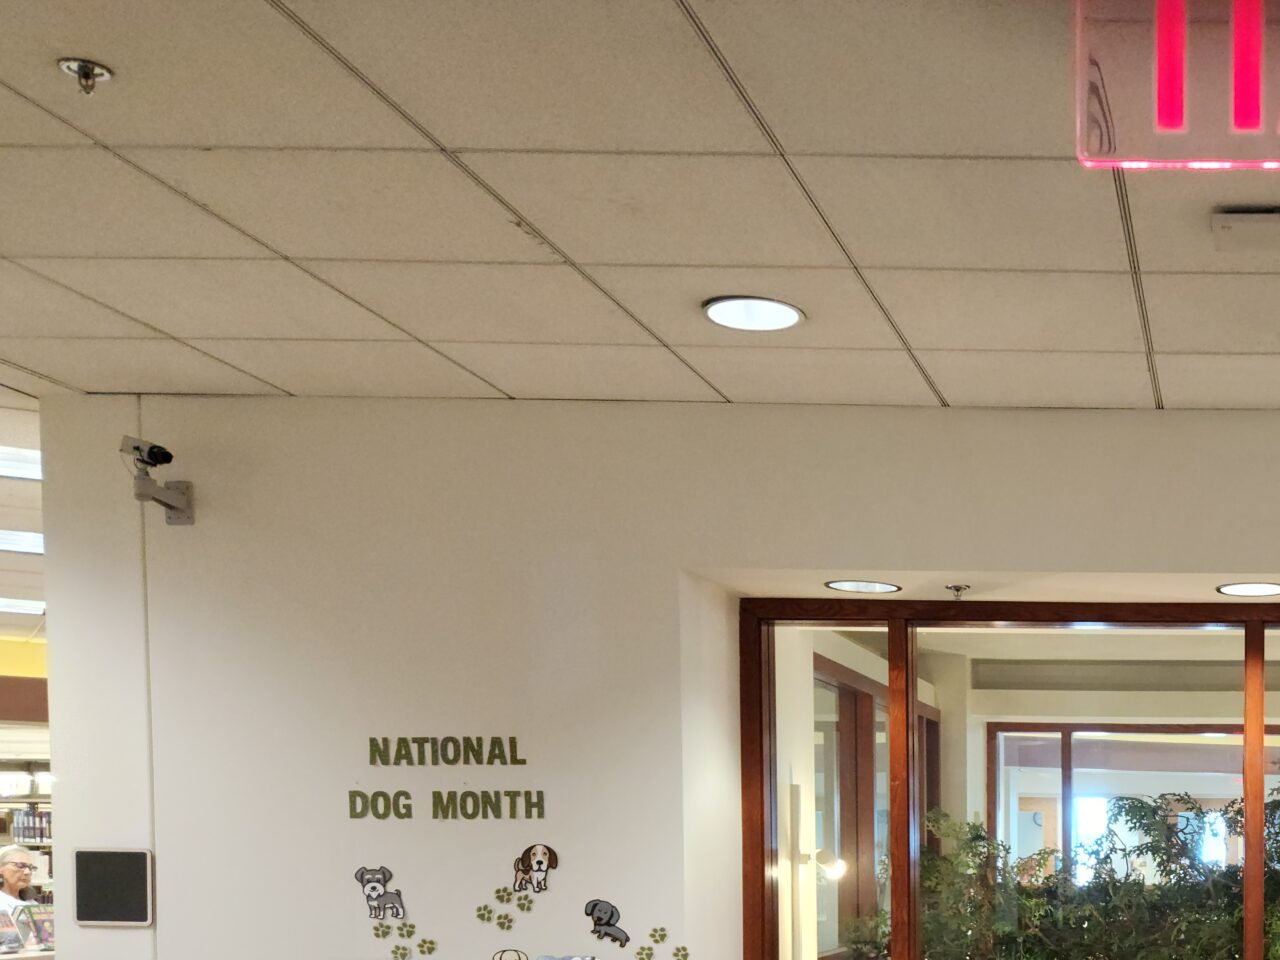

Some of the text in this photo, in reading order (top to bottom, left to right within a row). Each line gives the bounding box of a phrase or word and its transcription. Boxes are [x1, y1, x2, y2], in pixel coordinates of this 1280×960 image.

[369, 736, 527, 766] NATIONAL
[348, 790, 545, 820] DOG MONTH
